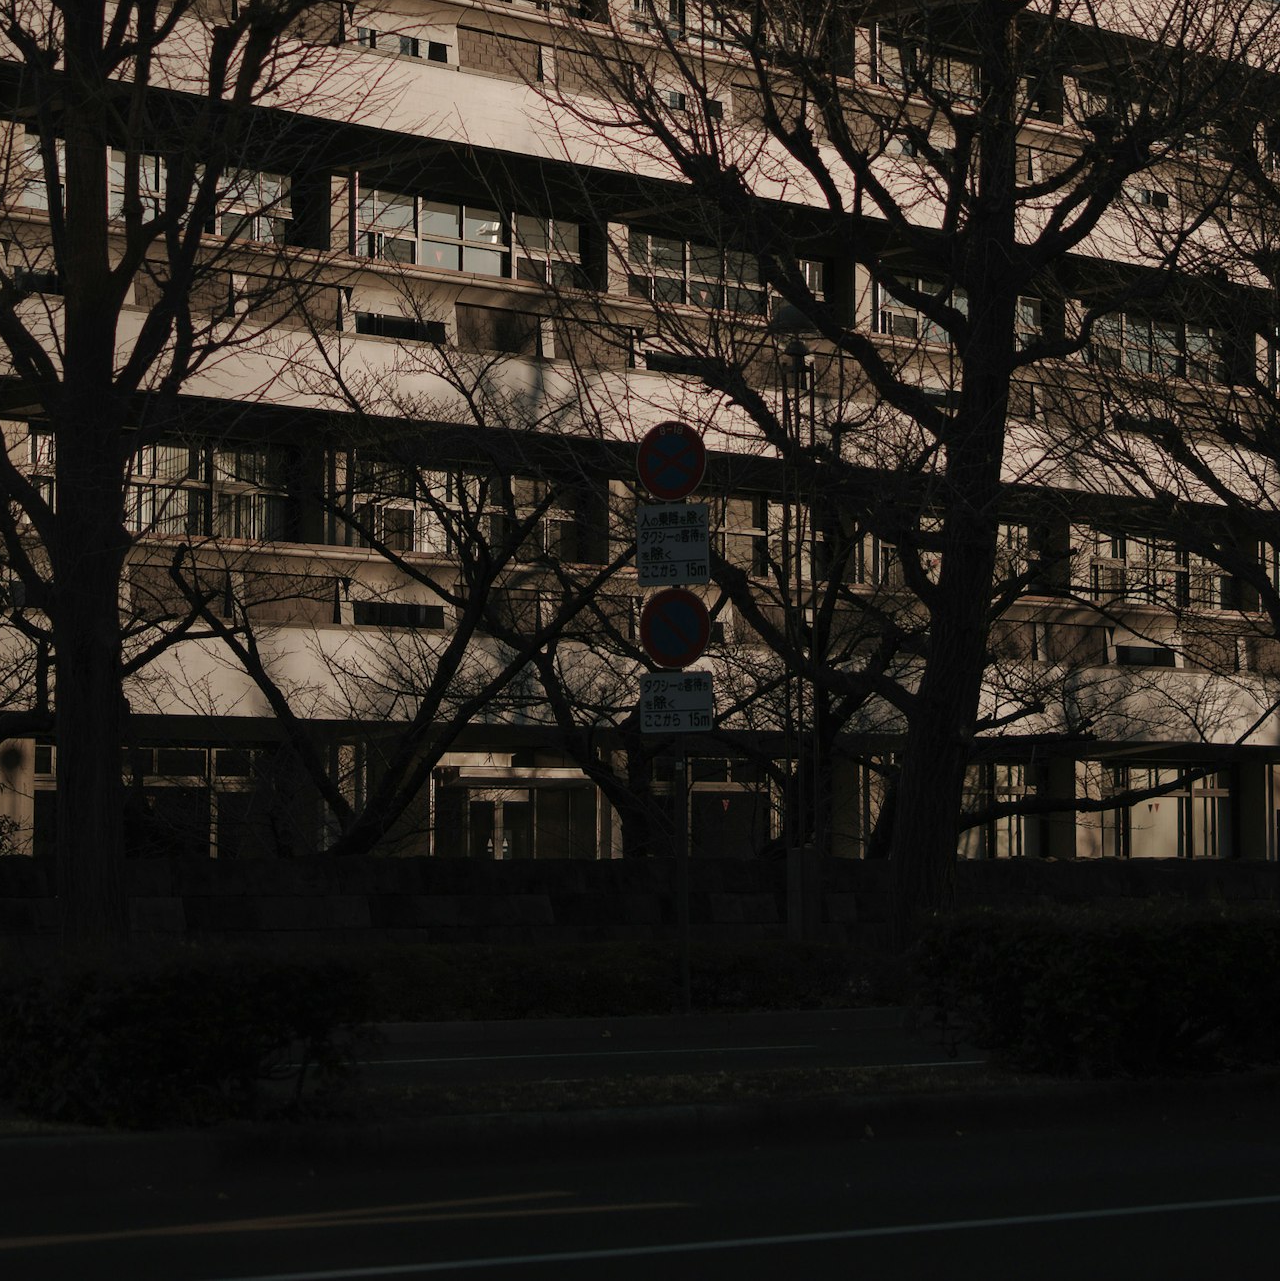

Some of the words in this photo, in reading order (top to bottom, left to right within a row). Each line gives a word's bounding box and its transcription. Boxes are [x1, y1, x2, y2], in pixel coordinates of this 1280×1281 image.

[659, 424, 683, 435] 8-18
[640, 510, 704, 526] 人の乗降を除く
[641, 528, 706, 543] タクシーの客待ち
[641, 547, 672, 560] を除く
[641, 563, 677, 578] ここから
[686, 562, 707, 577] 15m
[644, 678, 709, 693] タクシーの客待ち
[644, 695, 675, 710] を除く
[645, 712, 681, 727] ここから
[688, 711, 710, 726] 15m
